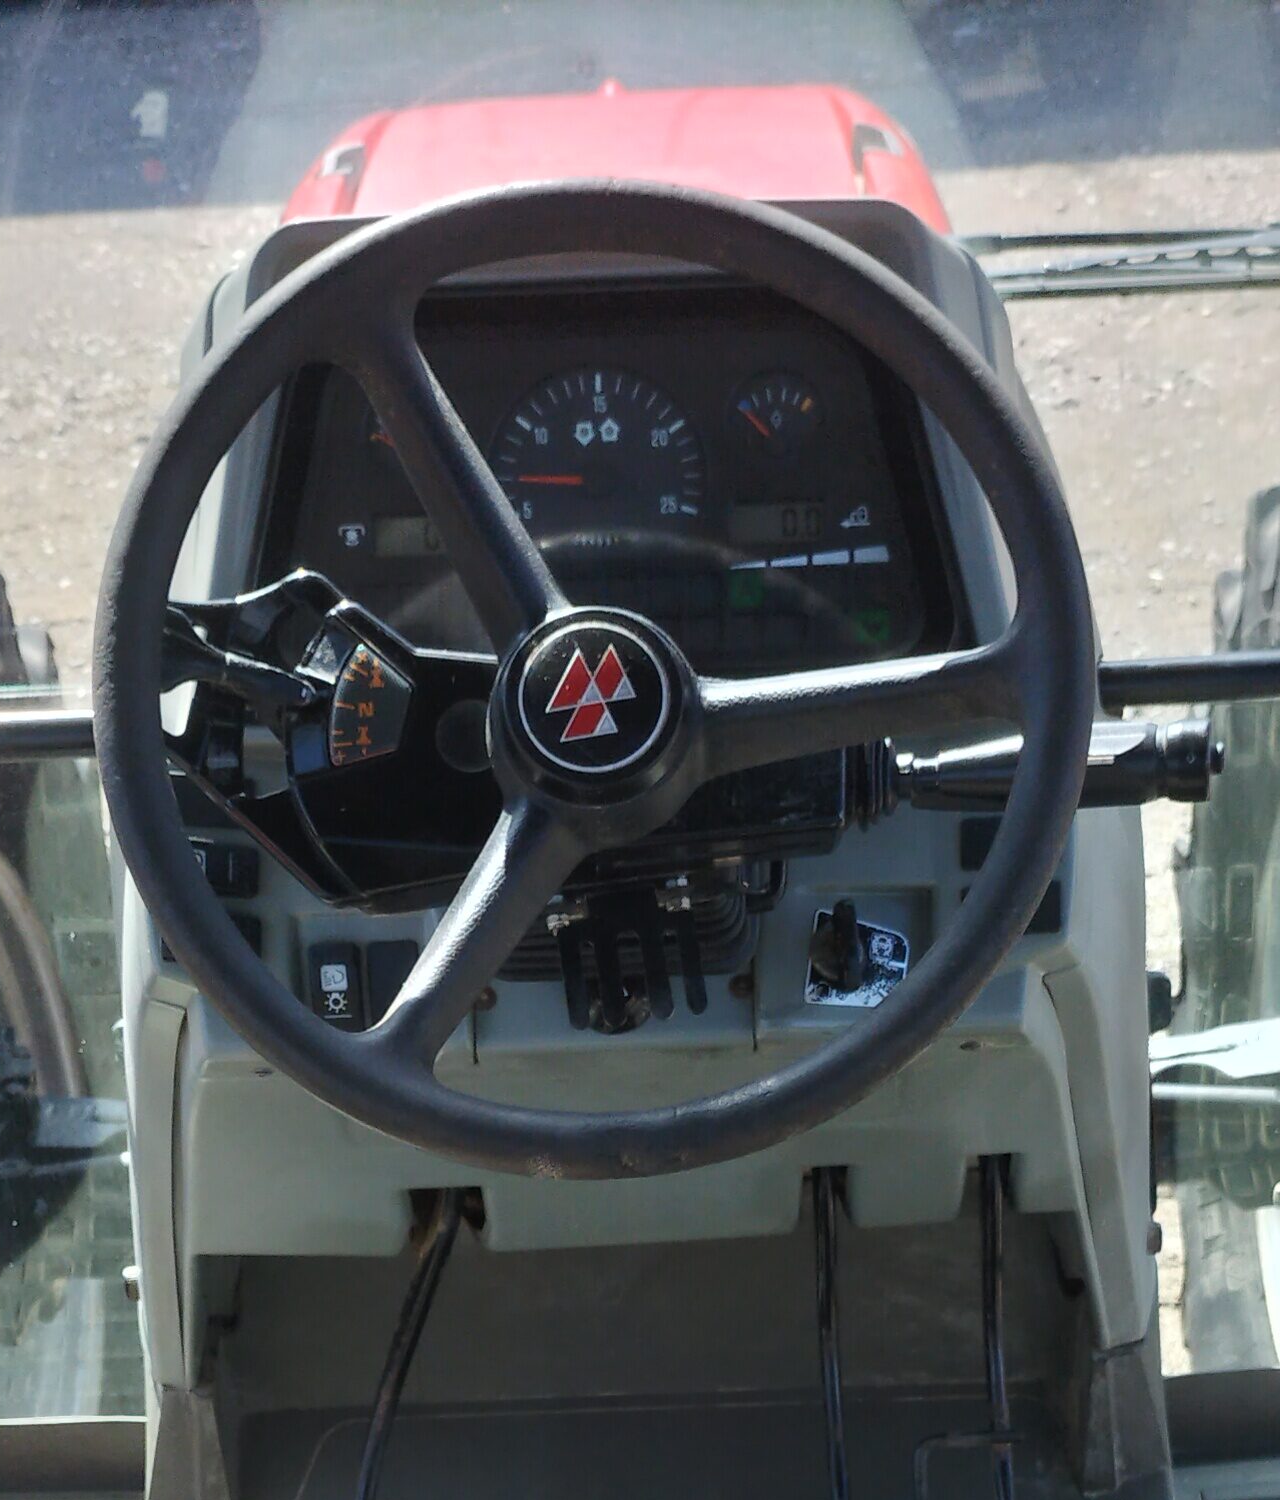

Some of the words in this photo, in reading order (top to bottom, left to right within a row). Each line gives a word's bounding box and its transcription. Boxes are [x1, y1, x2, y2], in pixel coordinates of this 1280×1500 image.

[593, 395, 607, 413] 15
[534, 427, 548, 445] 10
[651, 430, 669, 447] 20
[523, 502, 532, 519] 5
[660, 496, 678, 514] 25
